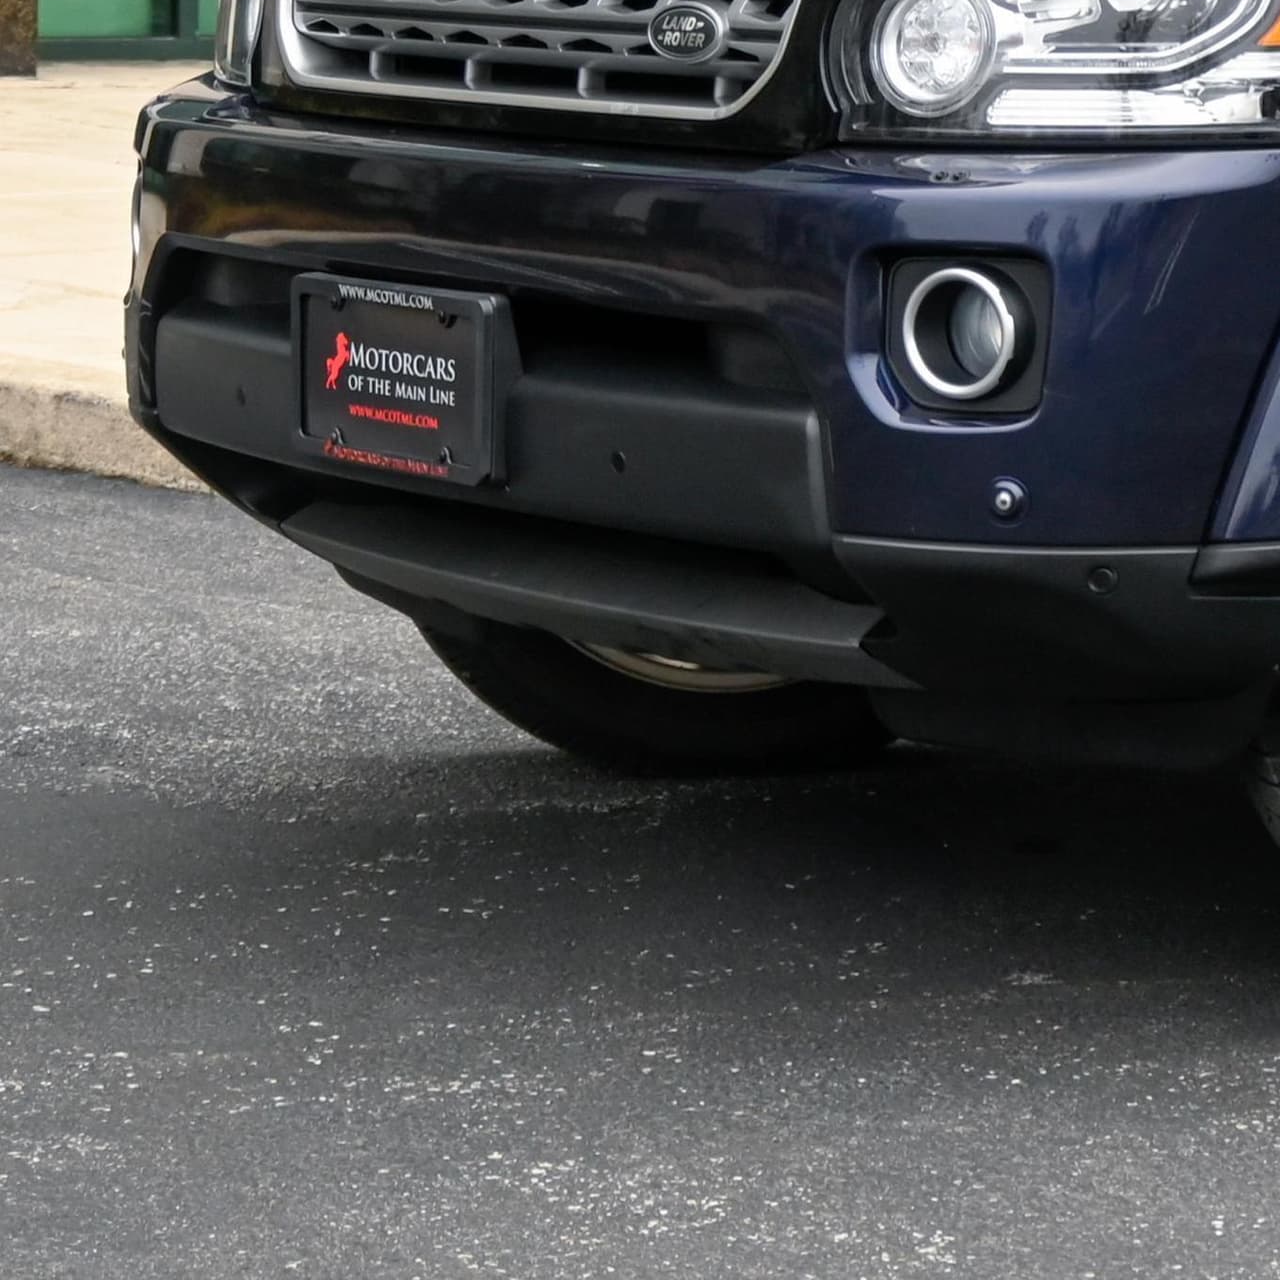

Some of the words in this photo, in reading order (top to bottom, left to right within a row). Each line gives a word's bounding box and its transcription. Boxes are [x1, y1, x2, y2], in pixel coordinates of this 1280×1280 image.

[662, 15, 698, 31] LAND
[663, 31, 705, 48] ROVER
[338, 284, 434, 311] WWW.MCOTML.COM
[349, 341, 456, 382] MOTORCARS
[348, 374, 364, 392] OF
[367, 377, 391, 396] THE
[395, 381, 426, 403] MAIN
[430, 385, 456, 407] LINE
[349, 404, 439, 430] WWW.MCOTML.COM
